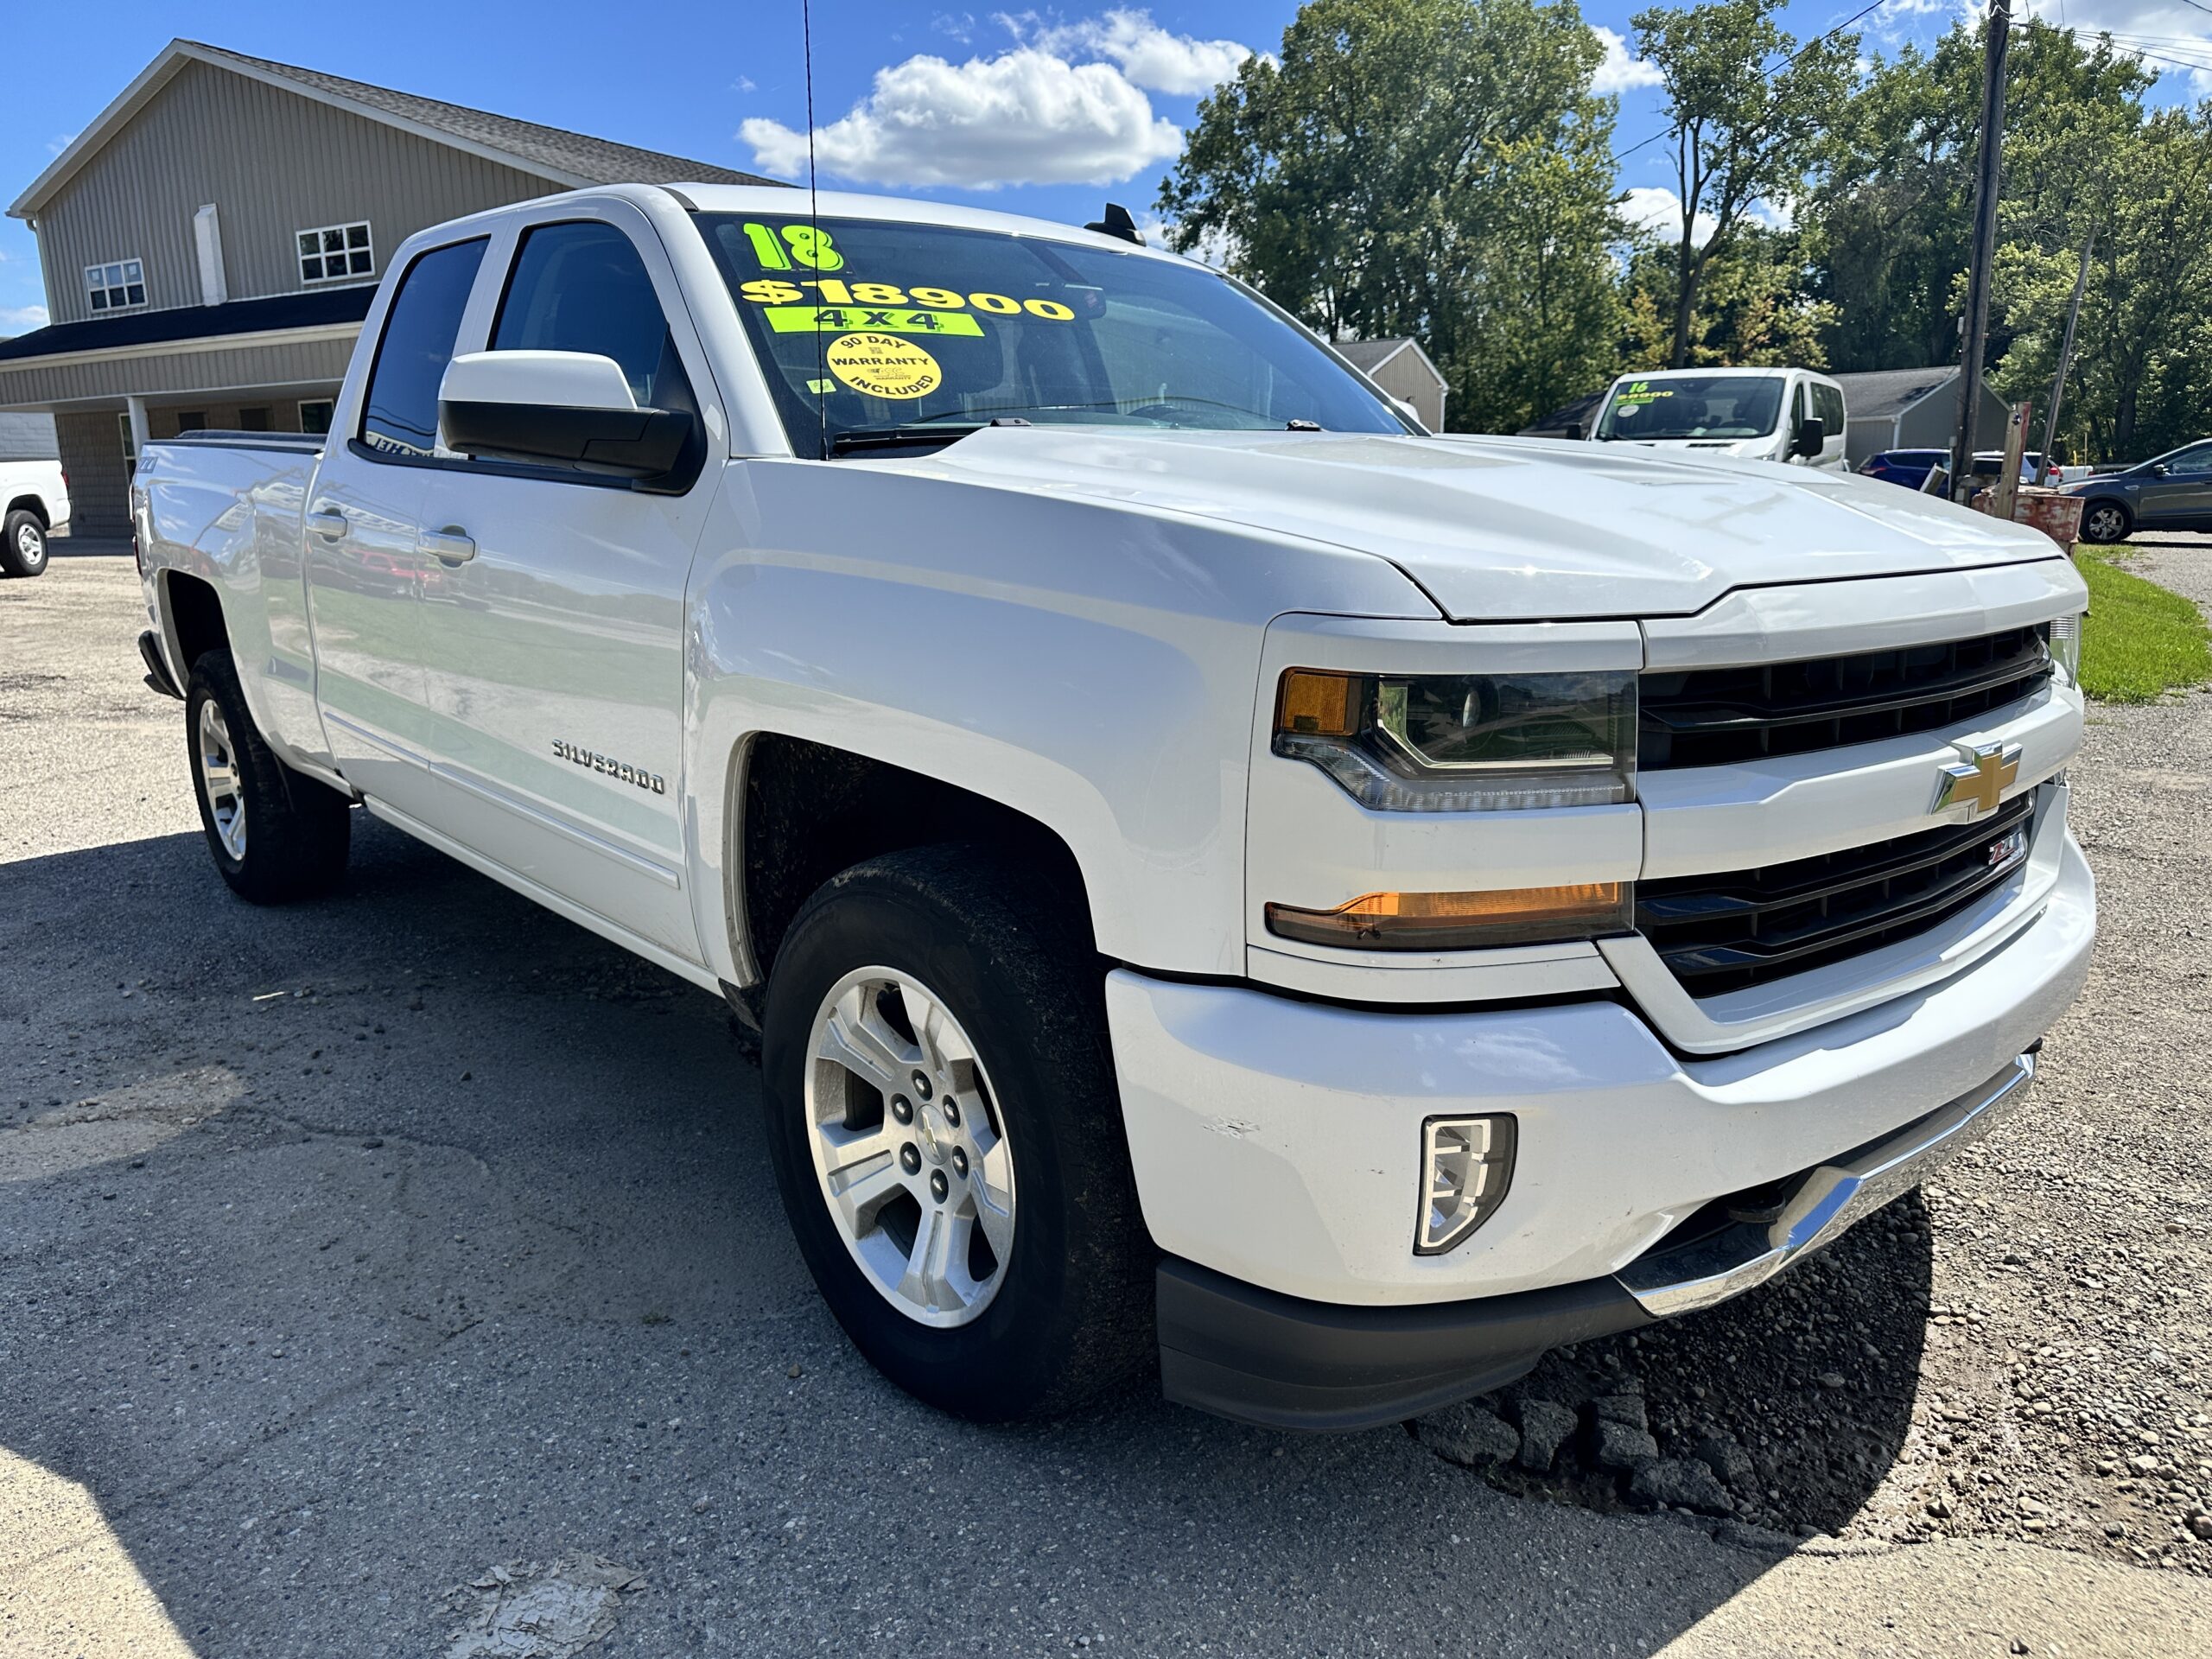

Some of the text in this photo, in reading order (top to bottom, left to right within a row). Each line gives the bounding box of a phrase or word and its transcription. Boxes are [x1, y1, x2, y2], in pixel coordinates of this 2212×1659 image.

[743, 223, 844, 270] 18
[741, 279, 1075, 321] $18900
[841, 335, 906, 348] 90 DAY
[849, 375, 934, 396] INCLUDED
[1629, 382, 1649, 393] 16
[551, 739, 664, 795] SILVERADO
